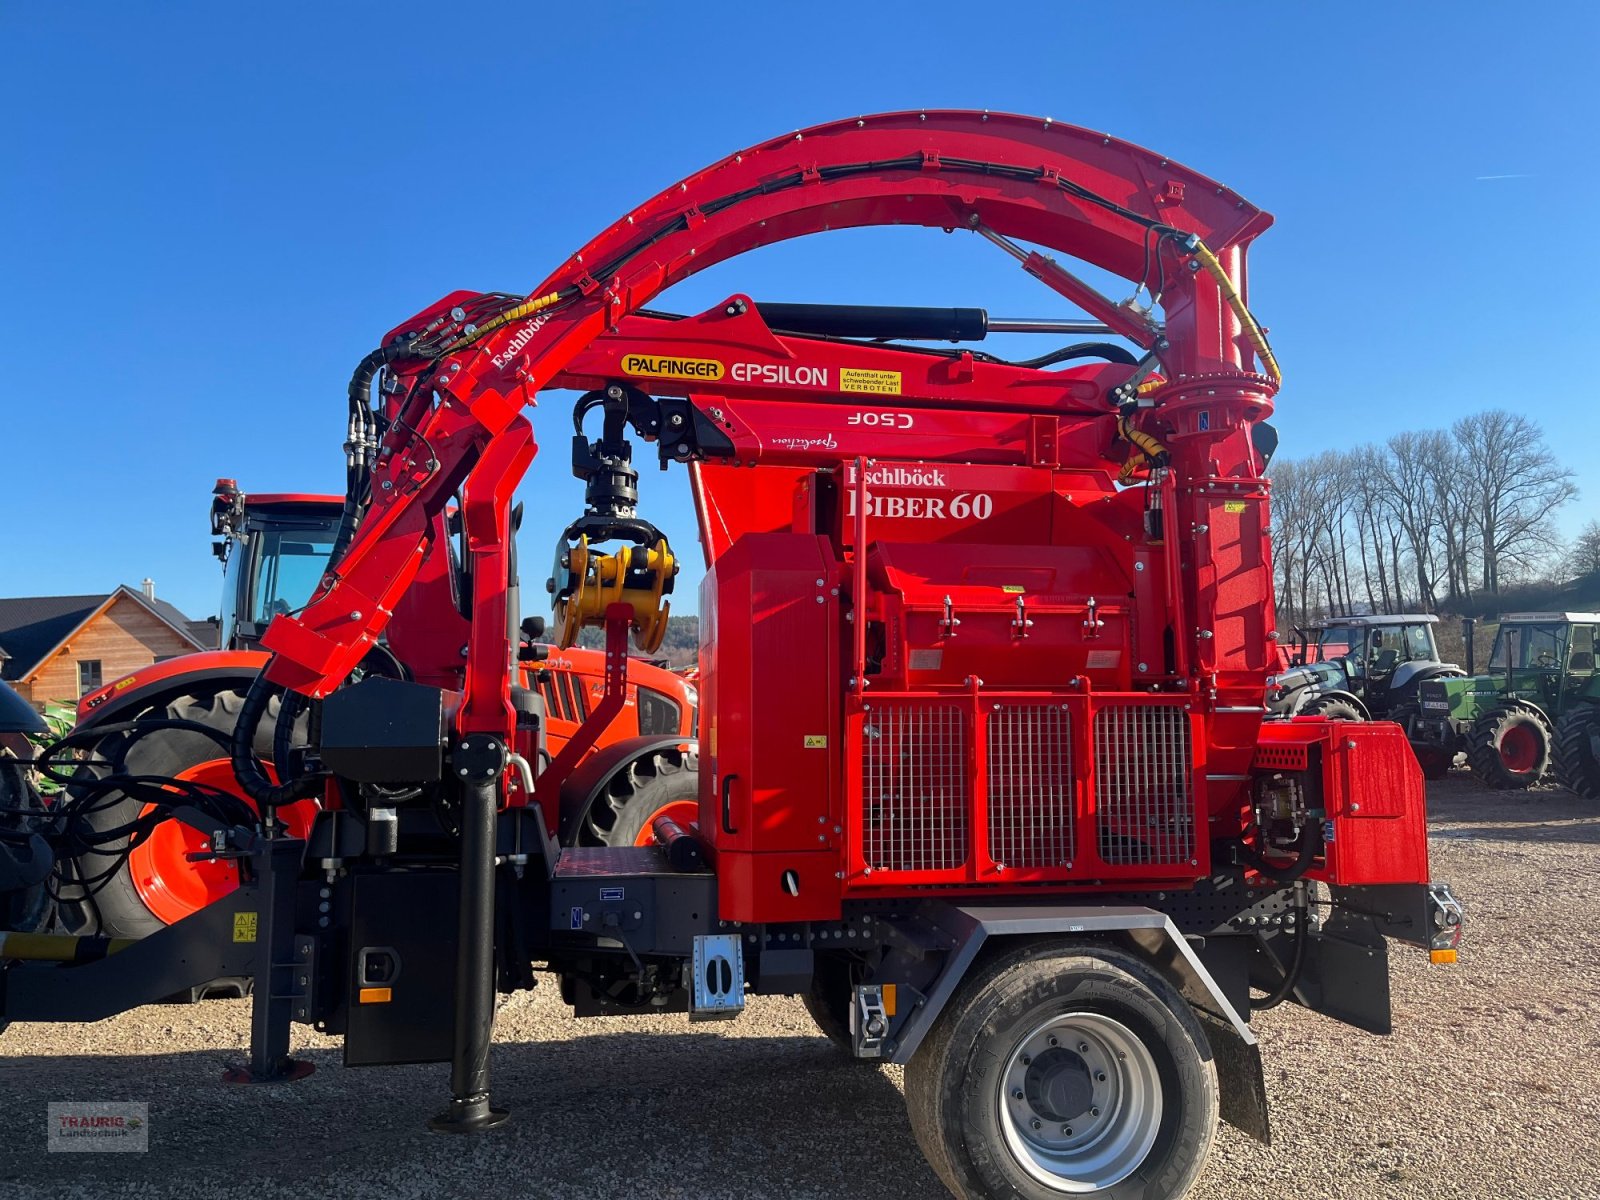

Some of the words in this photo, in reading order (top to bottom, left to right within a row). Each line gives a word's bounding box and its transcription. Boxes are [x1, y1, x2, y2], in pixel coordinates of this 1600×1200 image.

[628, 357, 718, 377] PALFINGER
[731, 362, 828, 387] EPSILON
[846, 370, 878, 379] Aufenthalt
[842, 377, 884, 385] schwebender
[847, 412, 914, 429] C50F
[949, 493, 993, 520] 60
